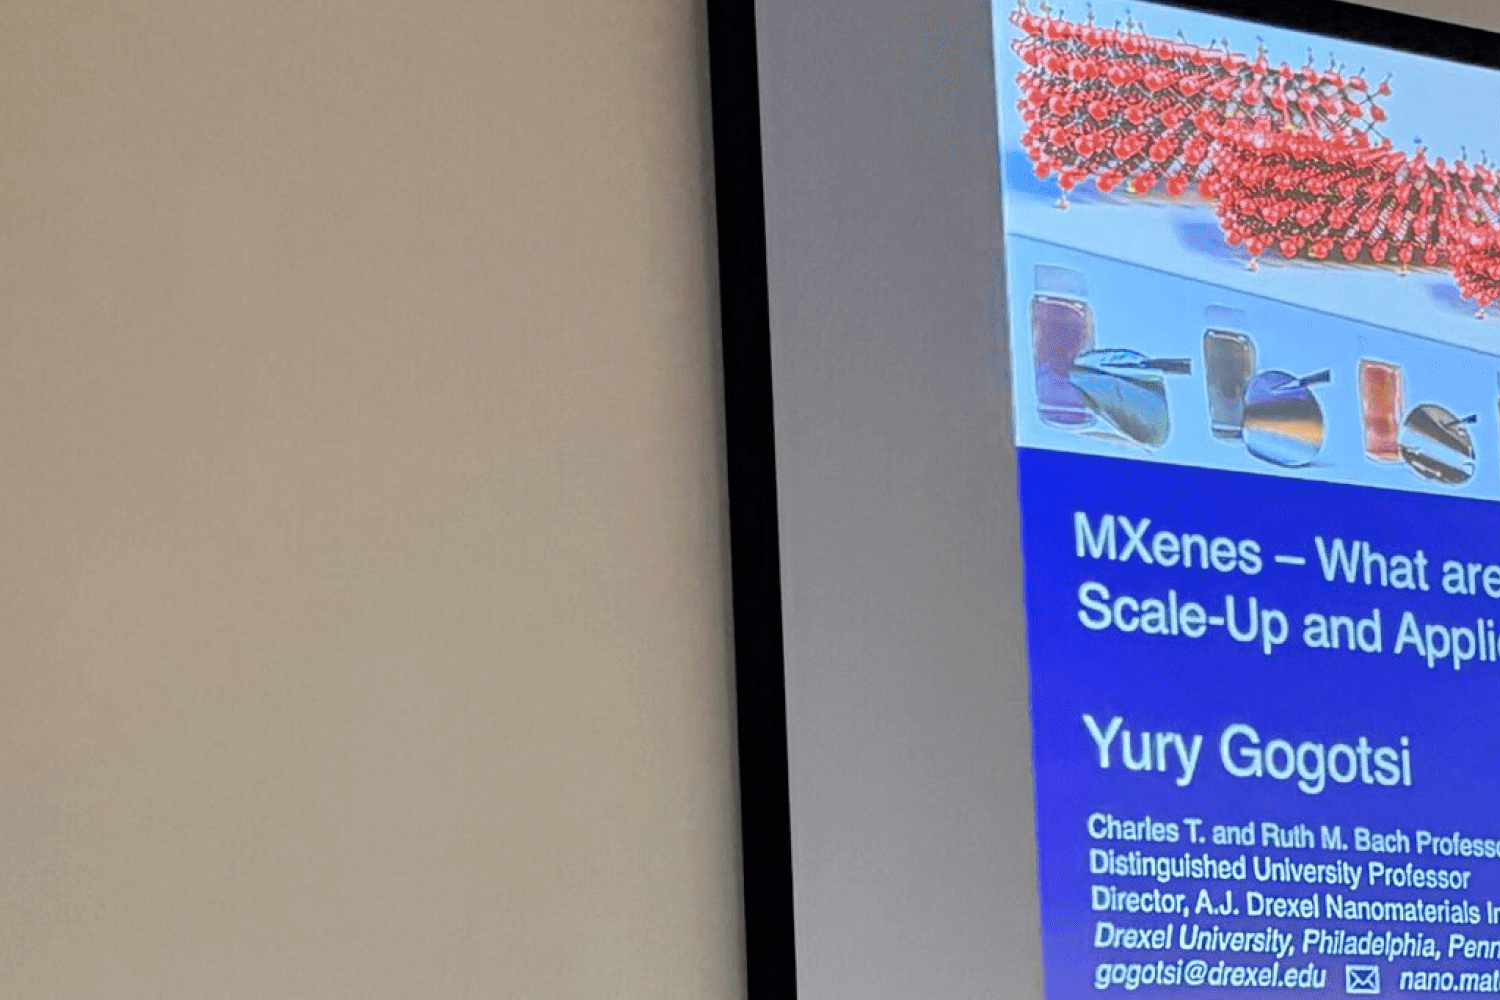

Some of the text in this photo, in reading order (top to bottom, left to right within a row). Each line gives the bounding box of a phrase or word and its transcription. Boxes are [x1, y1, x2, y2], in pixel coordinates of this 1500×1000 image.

[1074, 511, 1262, 575] MXenes
[1315, 536, 1429, 591] What
[1078, 581, 1288, 655] Scale-Up
[1303, 608, 1382, 653] and
[1082, 714, 1411, 794] Yury Gogotsi
[1087, 813, 1179, 843] Charles
[1183, 818, 1205, 844] T.
[1213, 822, 1255, 846] and
[1261, 823, 1315, 849] Ruth
[1321, 826, 1347, 851] M.
[1355, 828, 1409, 853] Bach
[1089, 848, 1470, 890] Distinguished University Professor
[1091, 885, 1189, 918] Director,
[1195, 890, 1239, 916] A.J.
[1246, 891, 1319, 919] Drexel
[1326, 894, 1480, 925] Nanomaterials
[1094, 921, 1173, 949] Drexel
[1179, 924, 1295, 958] University,
[1302, 929, 1441, 962] Philadelphia,
[1095, 959, 1326, 990] gogotsi@drexel.edu
